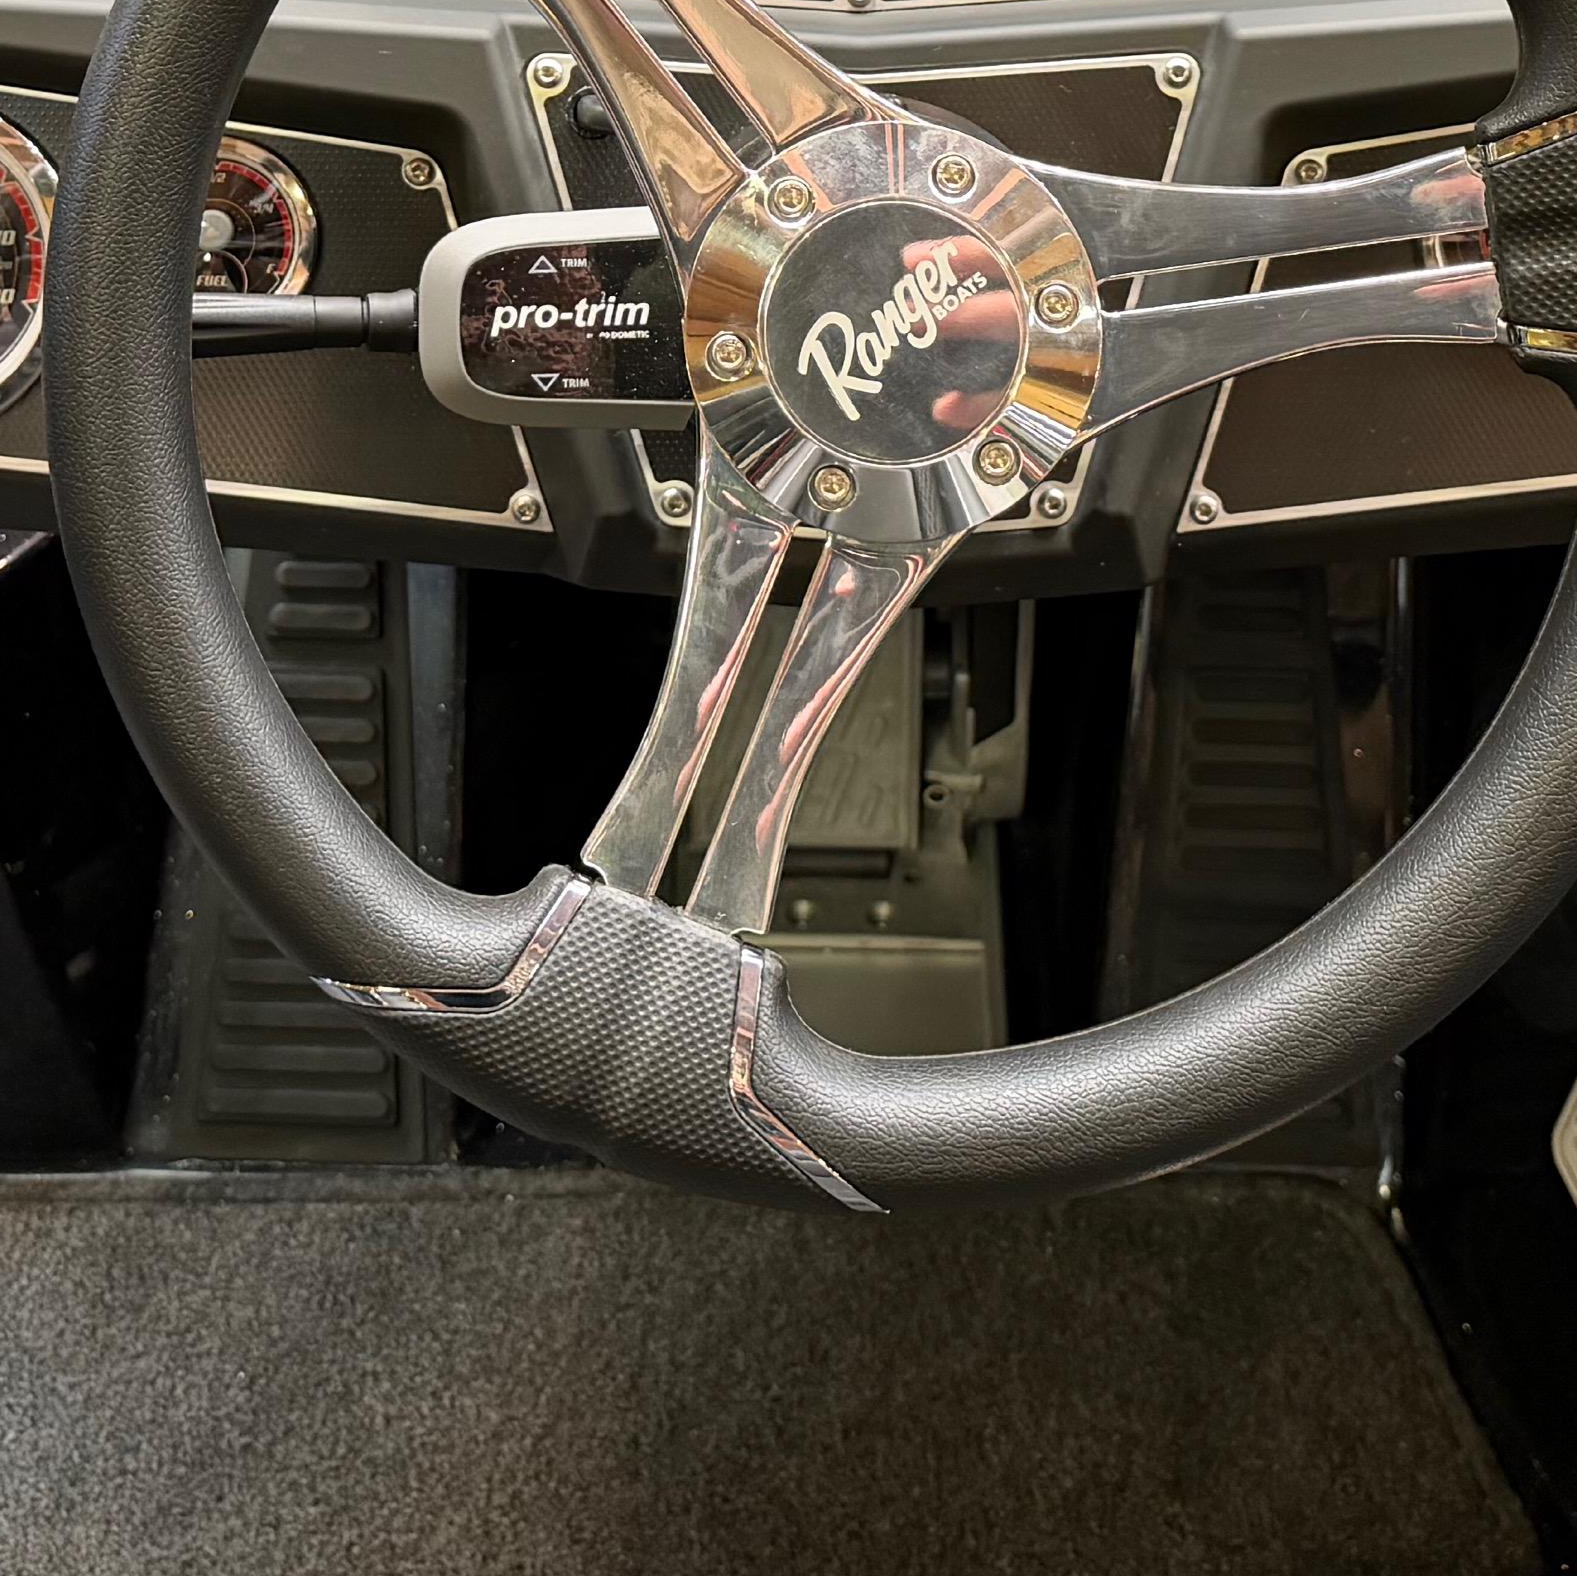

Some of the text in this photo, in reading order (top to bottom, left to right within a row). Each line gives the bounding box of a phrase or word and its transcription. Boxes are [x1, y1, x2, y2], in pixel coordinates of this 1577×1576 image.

[560, 258, 588, 268] TRIM
[196, 274, 229, 287] FUEL
[931, 271, 988, 321] BOATS
[490, 295, 651, 338] pro-trim
[611, 330, 651, 339] DOMETIC
[797, 242, 959, 422] Ranger
[562, 378, 590, 388] TRIM
